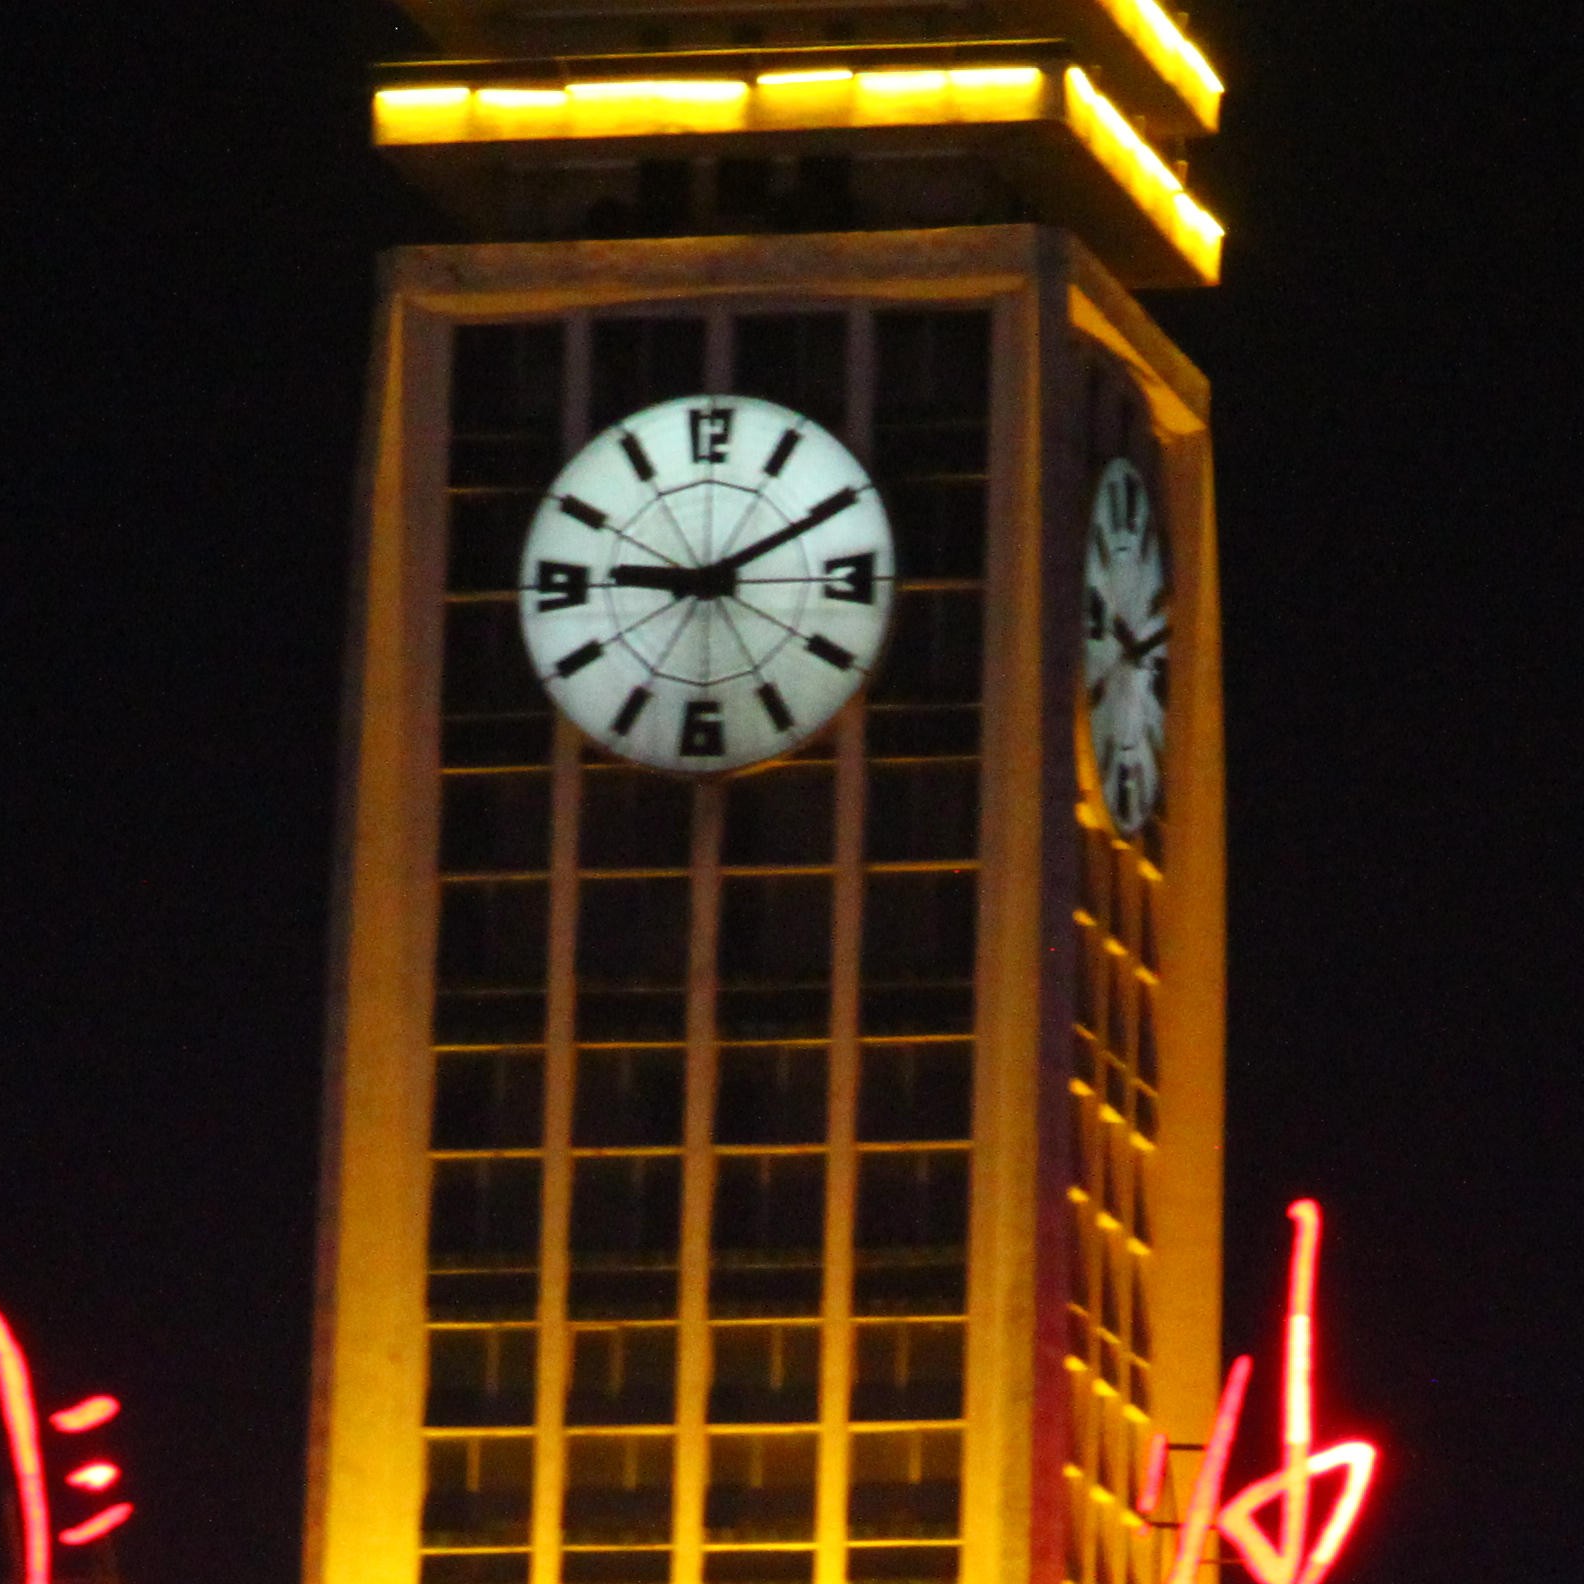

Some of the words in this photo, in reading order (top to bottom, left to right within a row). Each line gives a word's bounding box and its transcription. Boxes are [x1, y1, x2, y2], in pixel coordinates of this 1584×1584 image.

[689, 409, 735, 463] 12
[538, 560, 590, 612] 9
[824, 551, 875, 605] 3
[679, 701, 726, 756] 6
